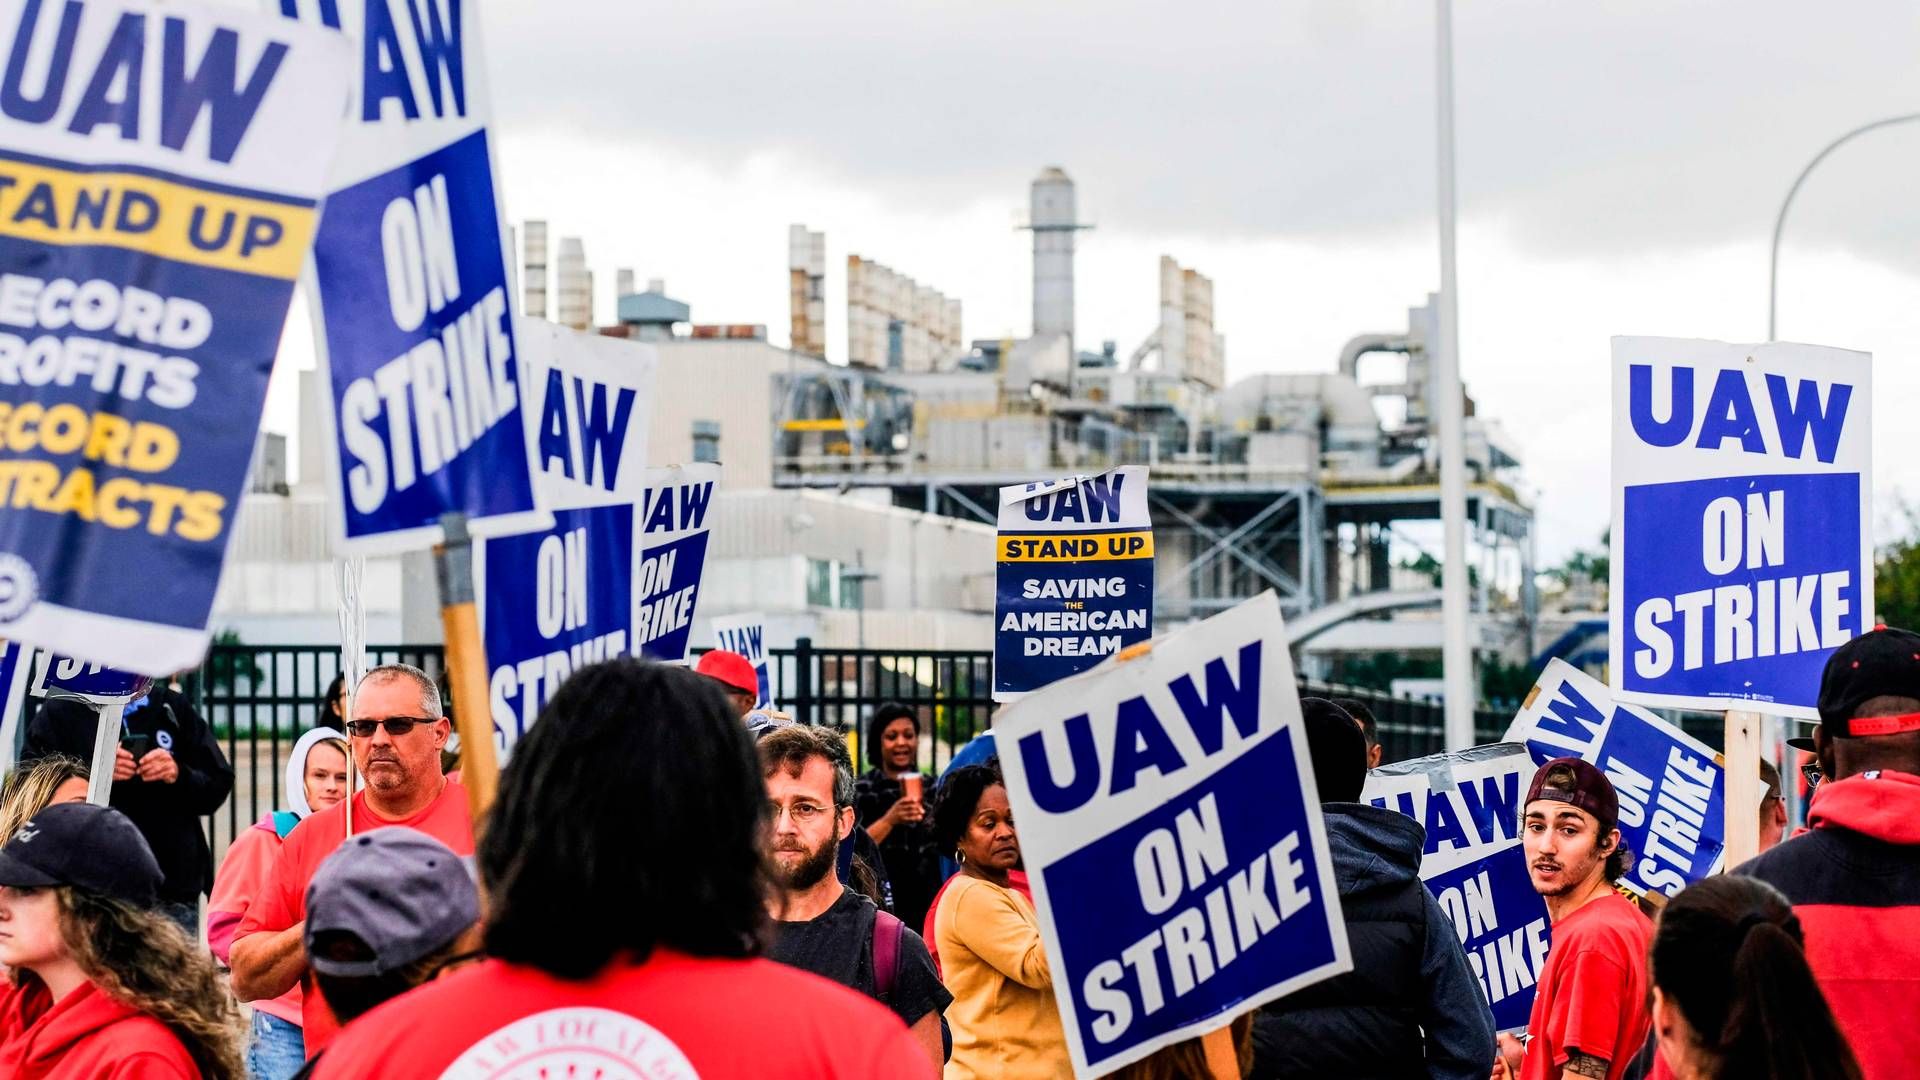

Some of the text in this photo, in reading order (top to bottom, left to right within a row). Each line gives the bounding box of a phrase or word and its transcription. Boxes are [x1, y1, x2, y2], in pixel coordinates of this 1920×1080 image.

[0, 0, 290, 163] UAW
[278, 0, 466, 121] AW
[187, 204, 283, 258] UP
[381, 173, 460, 332] ON
[341, 285, 518, 514] STRIKE
[539, 368, 637, 492] AW
[1629, 364, 1853, 464] UAW
[537, 527, 587, 639] ON
[640, 549, 677, 601] ON
[1006, 537, 1145, 558] STAND UP
[1703, 490, 1784, 576] ON
[640, 584, 695, 645] RIKE
[1000, 609, 1147, 632] AMERICAN
[1022, 577, 1126, 599] SAVING
[1064, 602, 1083, 610] THE
[1634, 570, 1852, 679] STRIKE
[1024, 635, 1122, 656] DREAM
[1018, 639, 1262, 815] UAW
[1133, 792, 1229, 915] ON
[1638, 745, 1717, 898] STRIKE
[1082, 831, 1312, 1044] STRIKE
[1438, 870, 1498, 945] ON
